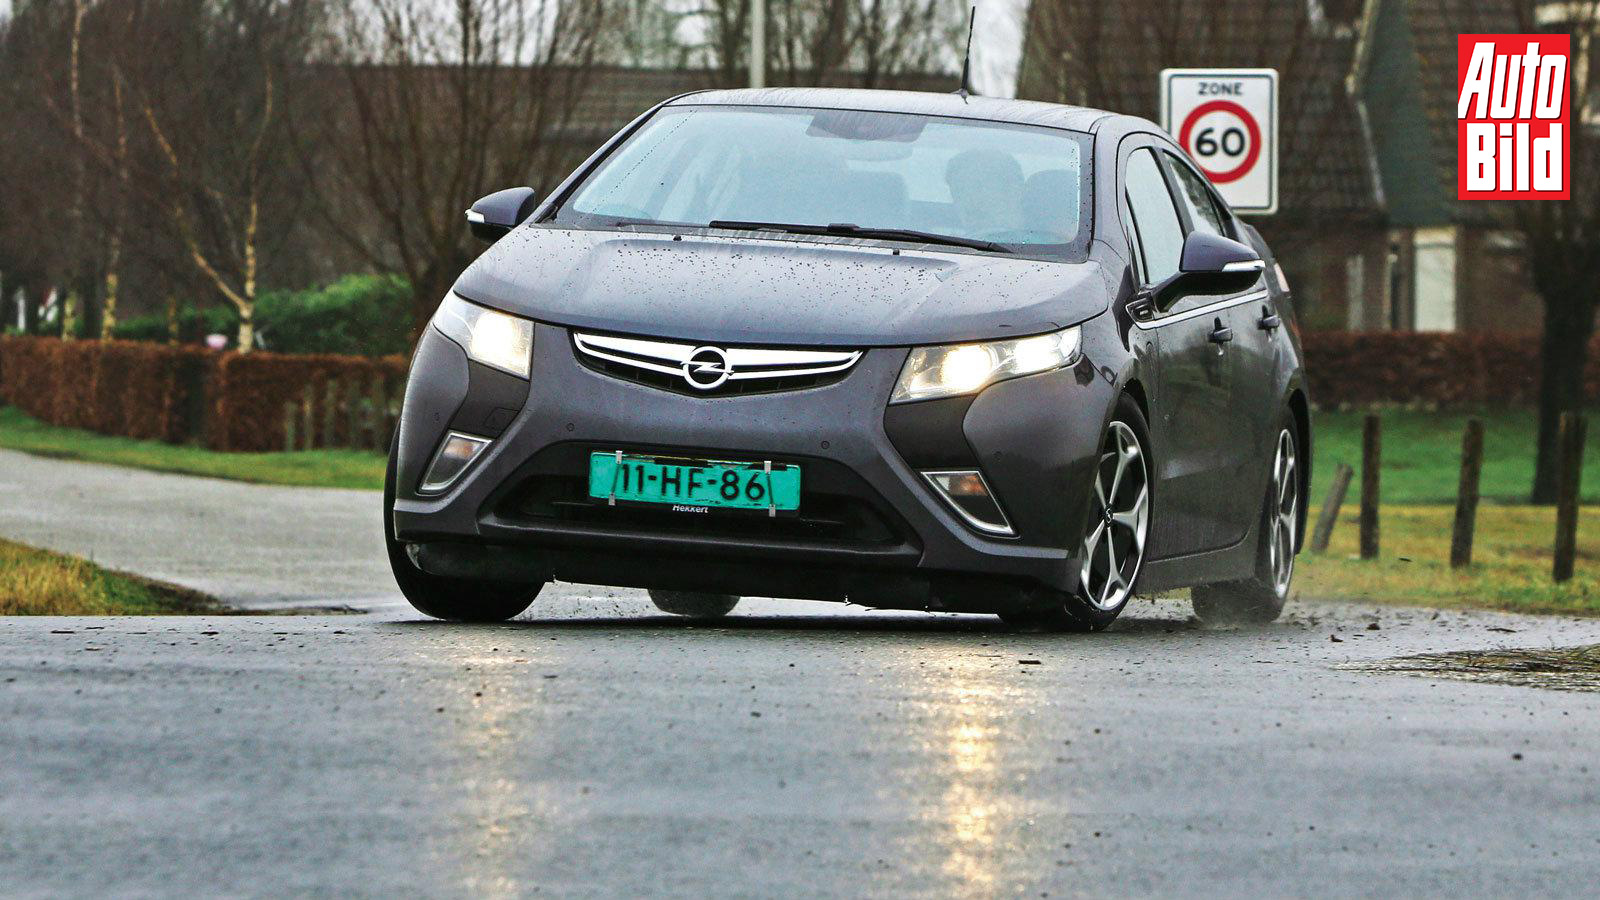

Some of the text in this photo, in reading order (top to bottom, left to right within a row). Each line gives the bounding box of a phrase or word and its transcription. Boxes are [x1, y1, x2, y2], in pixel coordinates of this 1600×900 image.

[1198, 82, 1243, 95] ZONE
[1196, 127, 1245, 157] 60
[621, 463, 765, 501] 11-HF-86
